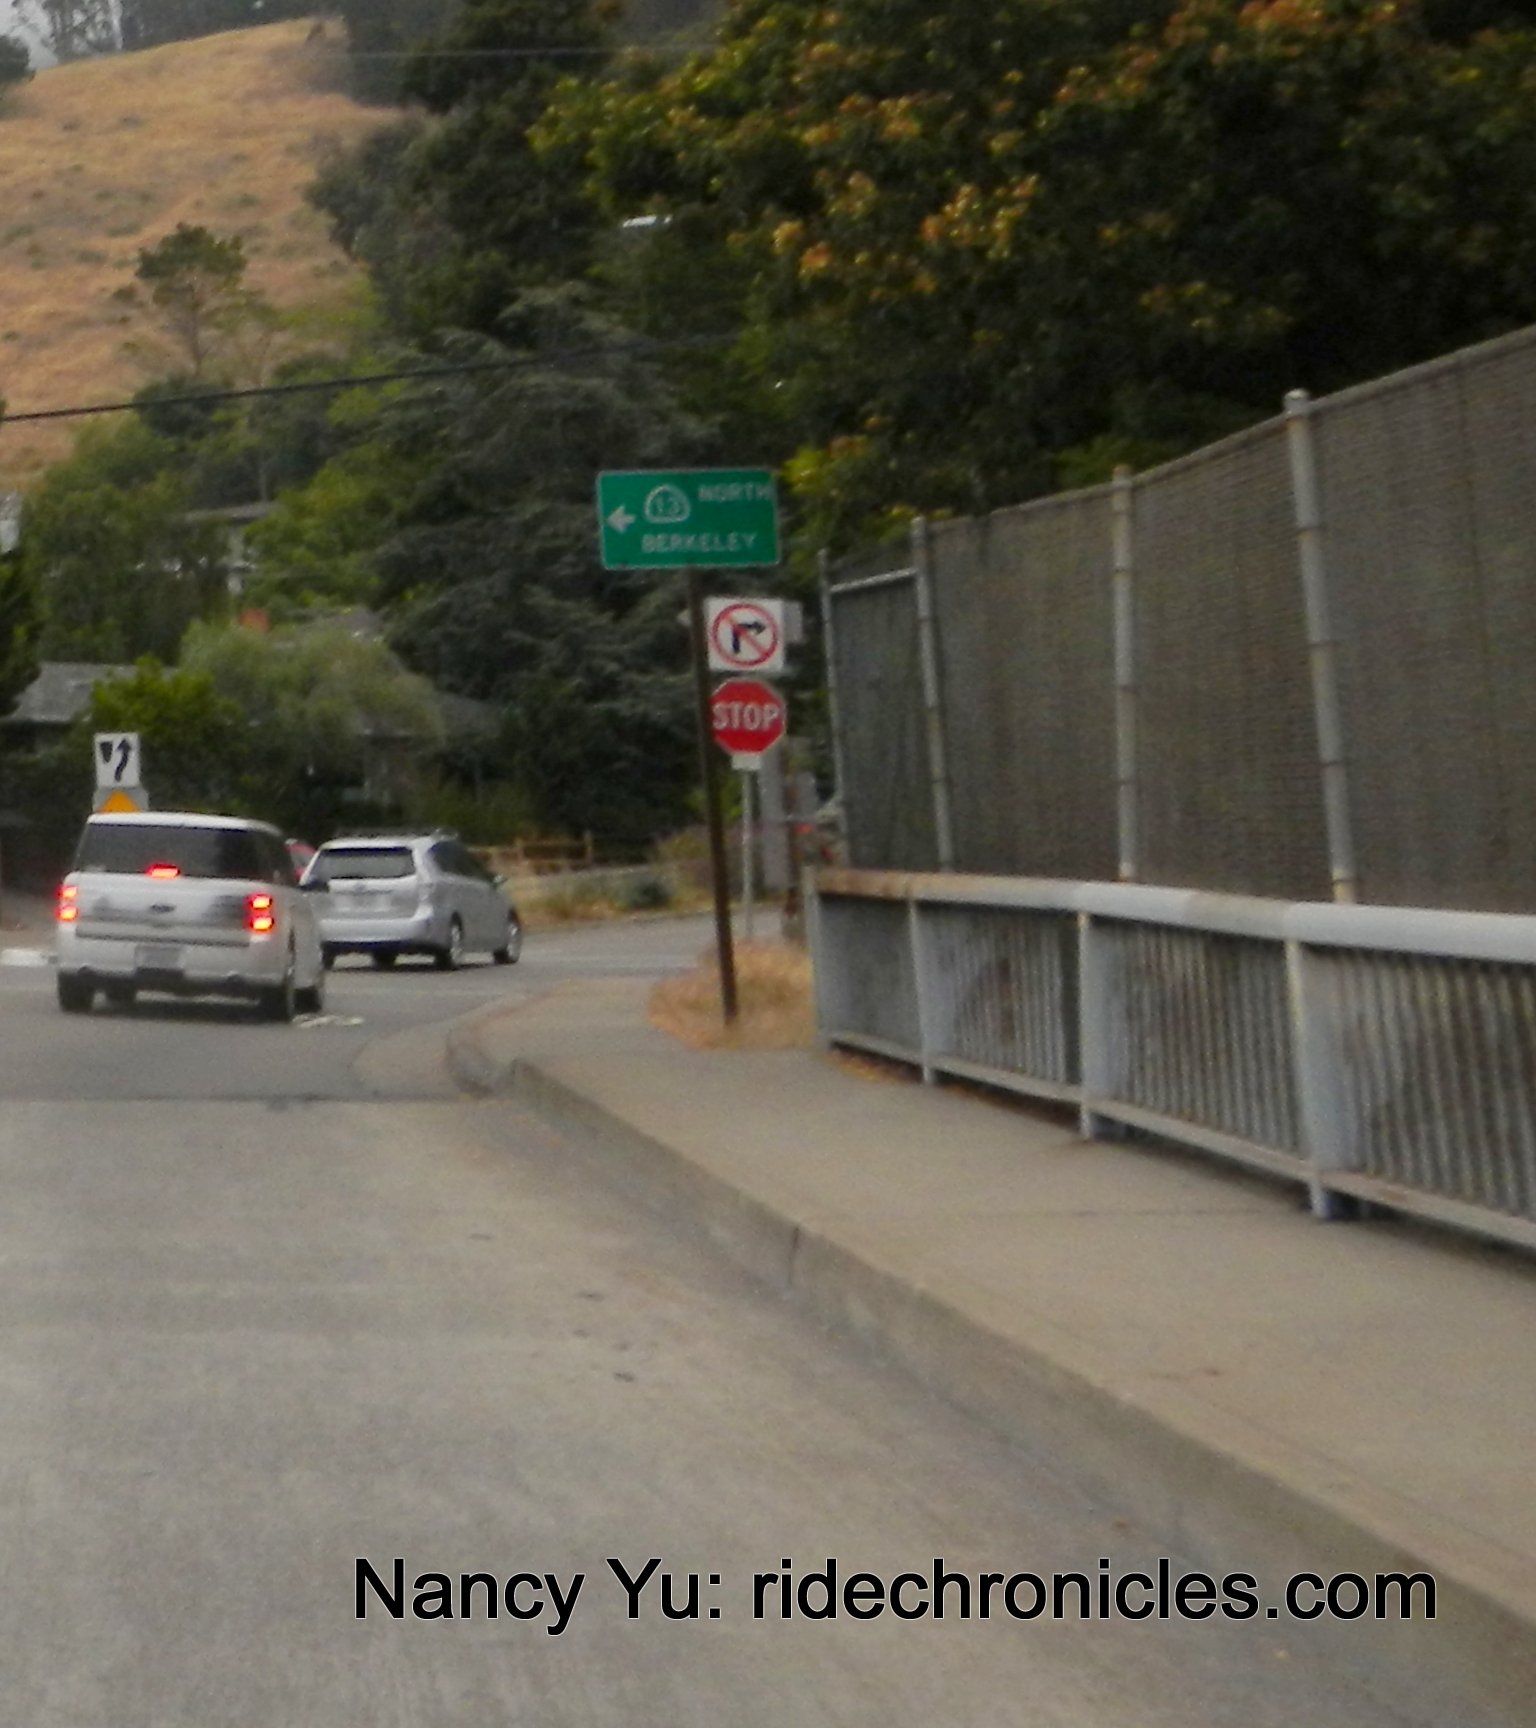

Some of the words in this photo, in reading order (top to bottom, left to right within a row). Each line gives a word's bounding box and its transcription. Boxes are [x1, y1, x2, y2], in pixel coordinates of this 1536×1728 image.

[698, 482, 772, 502] NORTH
[641, 532, 756, 553] BERKELEY
[712, 702, 778, 731] STOP
